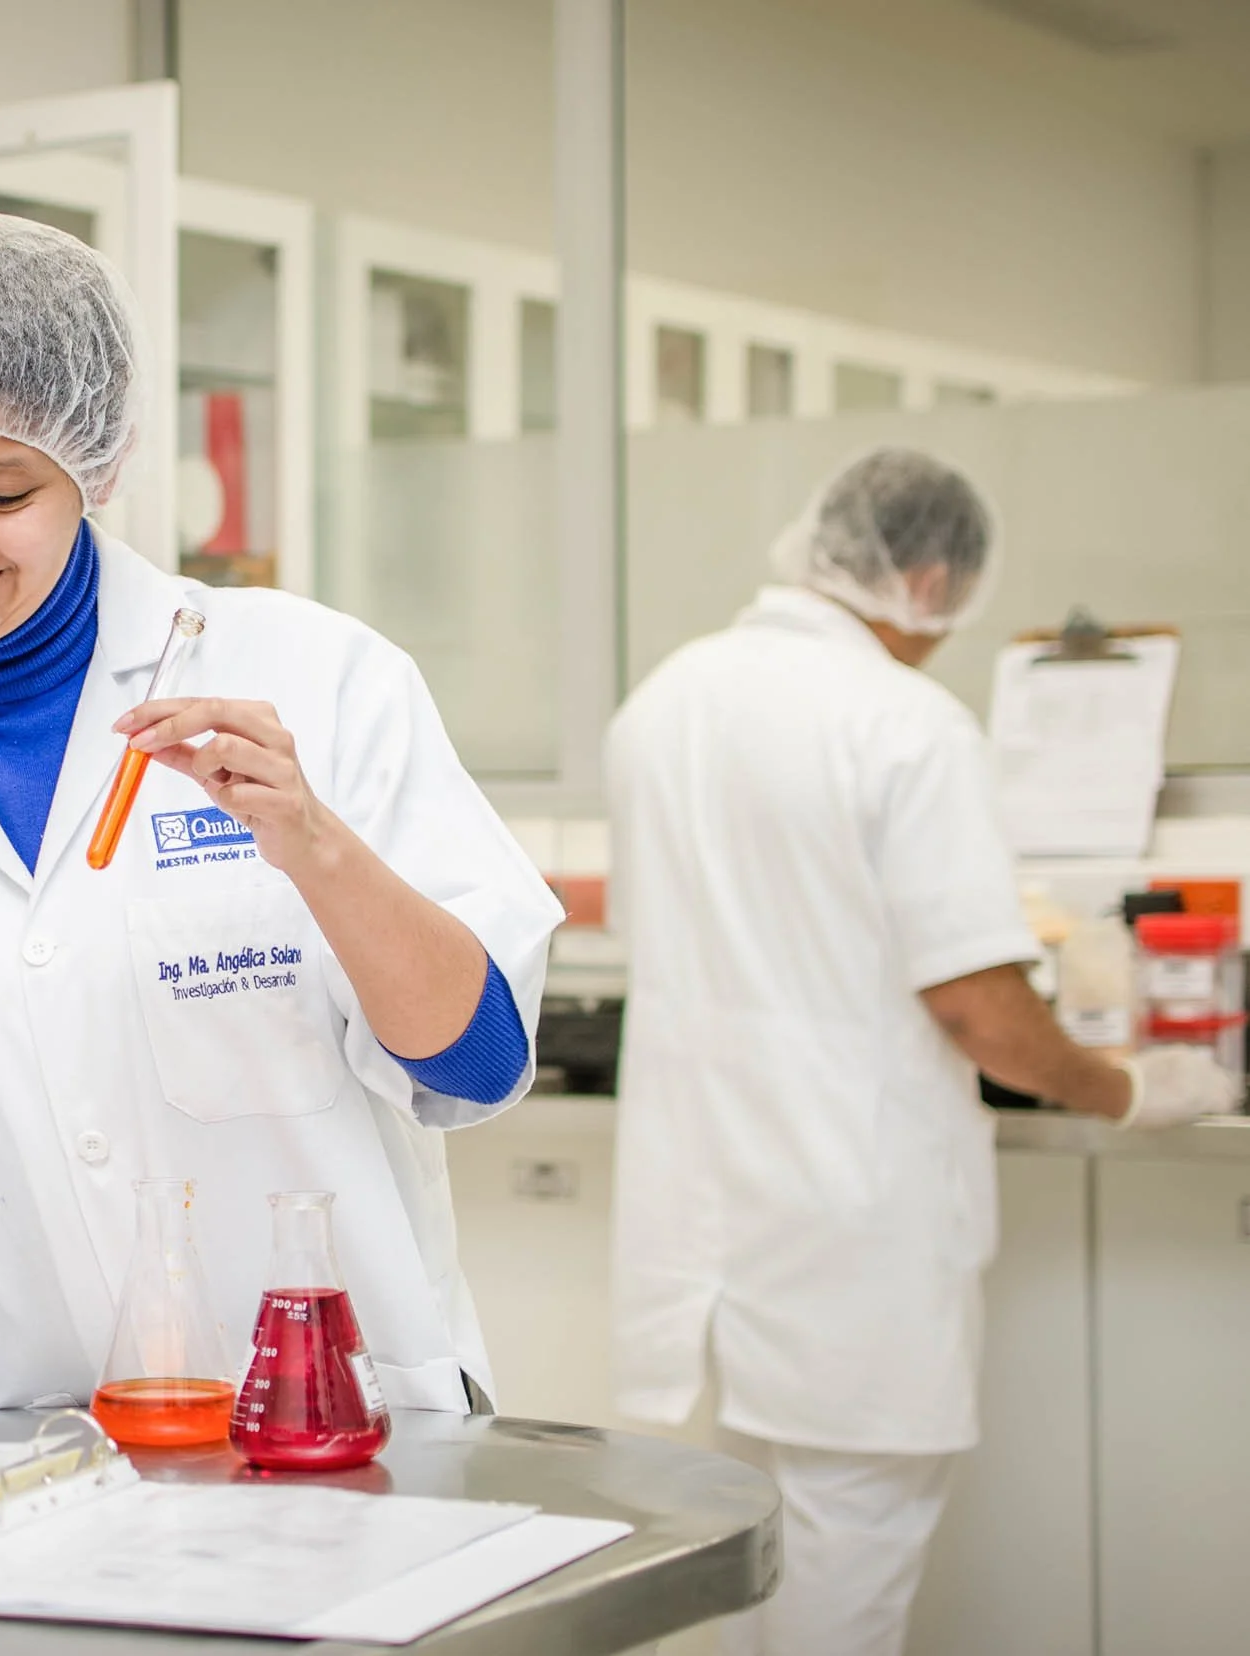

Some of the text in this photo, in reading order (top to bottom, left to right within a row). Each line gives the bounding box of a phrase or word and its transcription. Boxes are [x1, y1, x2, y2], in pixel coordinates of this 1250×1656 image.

[190, 817, 252, 840] Quala
[156, 848, 256, 871] NUESTRA PASIÓN ES
[158, 961, 182, 983] Ing.
[189, 956, 209, 976] Ma.
[216, 946, 266, 974] Angélica
[172, 971, 296, 1000] Investigación & Desarrollo
[272, 1299, 307, 1311] 300 ml
[261, 1347, 278, 1358] 250
[254, 1379, 270, 1389] 200
[250, 1403, 265, 1413] 150
[246, 1422, 260, 1432] 100
